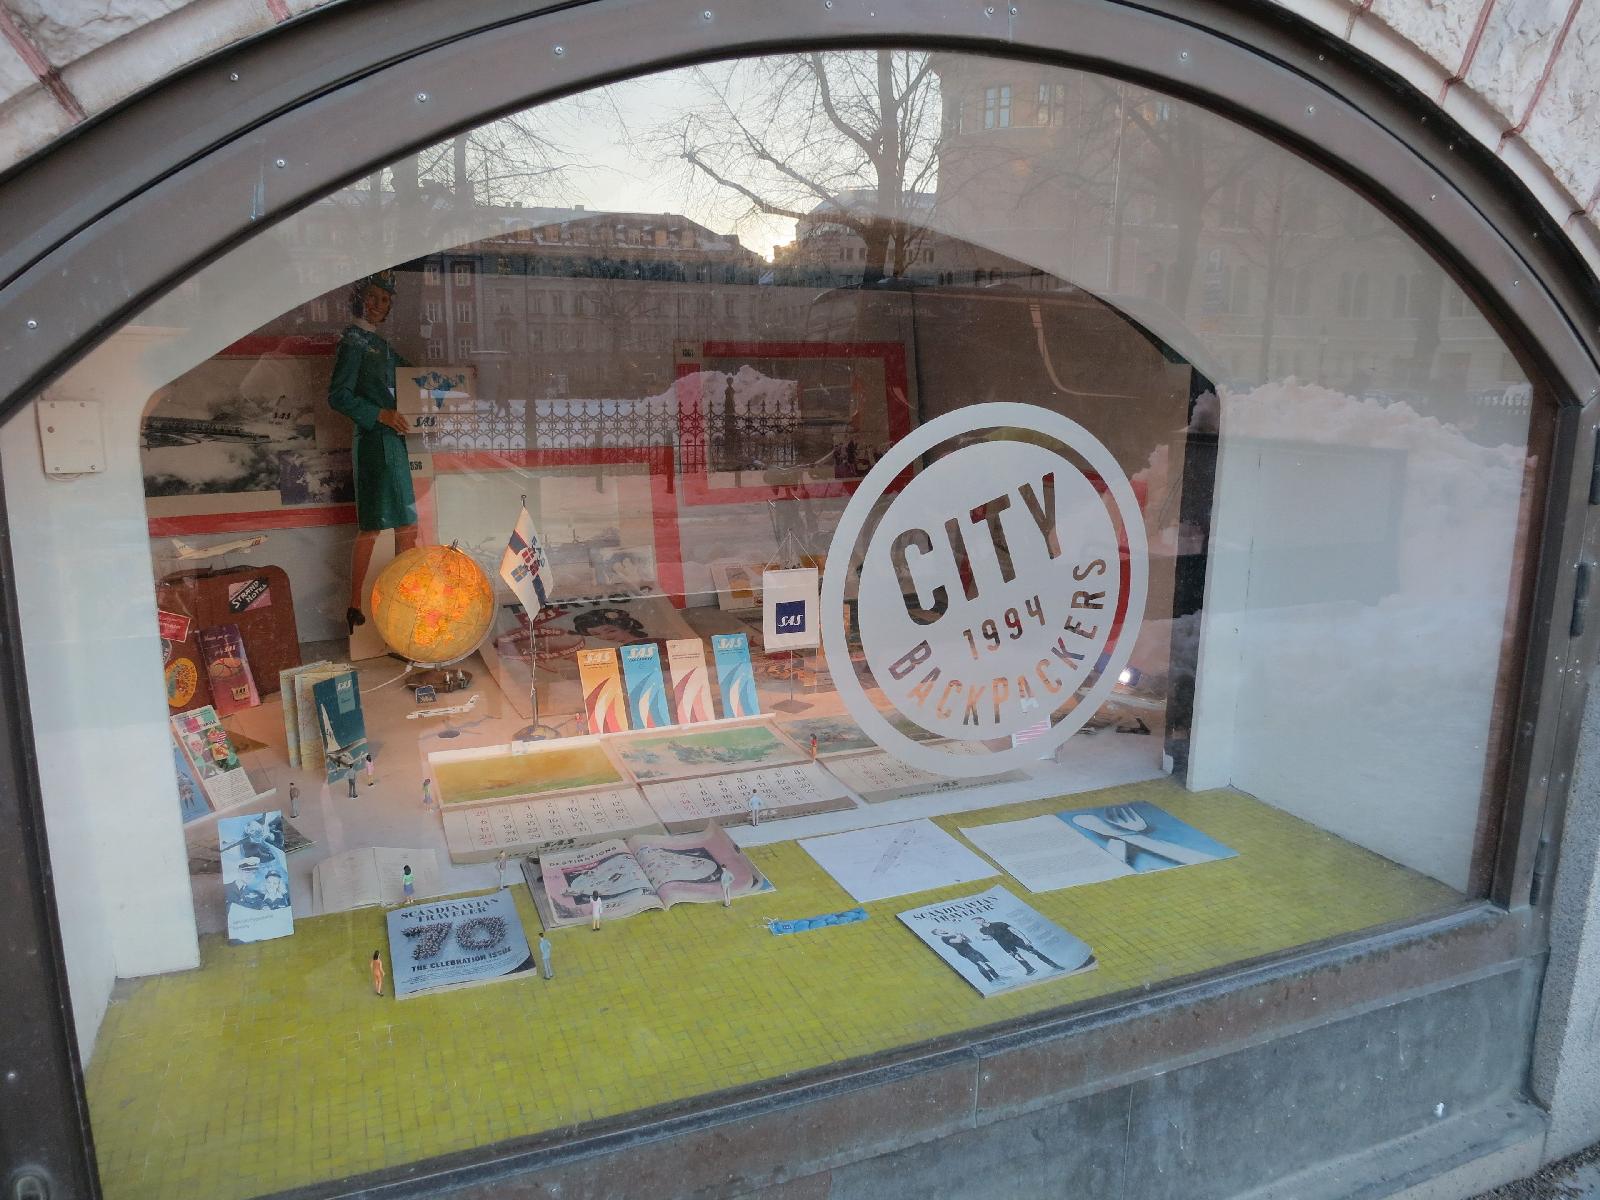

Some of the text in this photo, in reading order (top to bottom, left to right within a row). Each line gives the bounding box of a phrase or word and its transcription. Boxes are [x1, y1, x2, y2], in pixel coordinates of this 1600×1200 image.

[413, 416, 437, 428] SAS
[890, 471, 1061, 626] CITY
[777, 614, 804, 627] SAS
[963, 595, 1045, 660] 1994
[627, 646, 654, 659] SAS
[716, 638, 743, 649] SAS
[888, 558, 1107, 726] BACKPACKERS
[401, 898, 499, 920] SCANDINAVIAN
[417, 906, 488, 923] TRAVELER
[913, 896, 999, 921] SCANDINAVIAN
[930, 903, 994, 924] TRAVELER
[401, 915, 508, 961] 70
[430, 955, 486, 969] CELEBRATION
